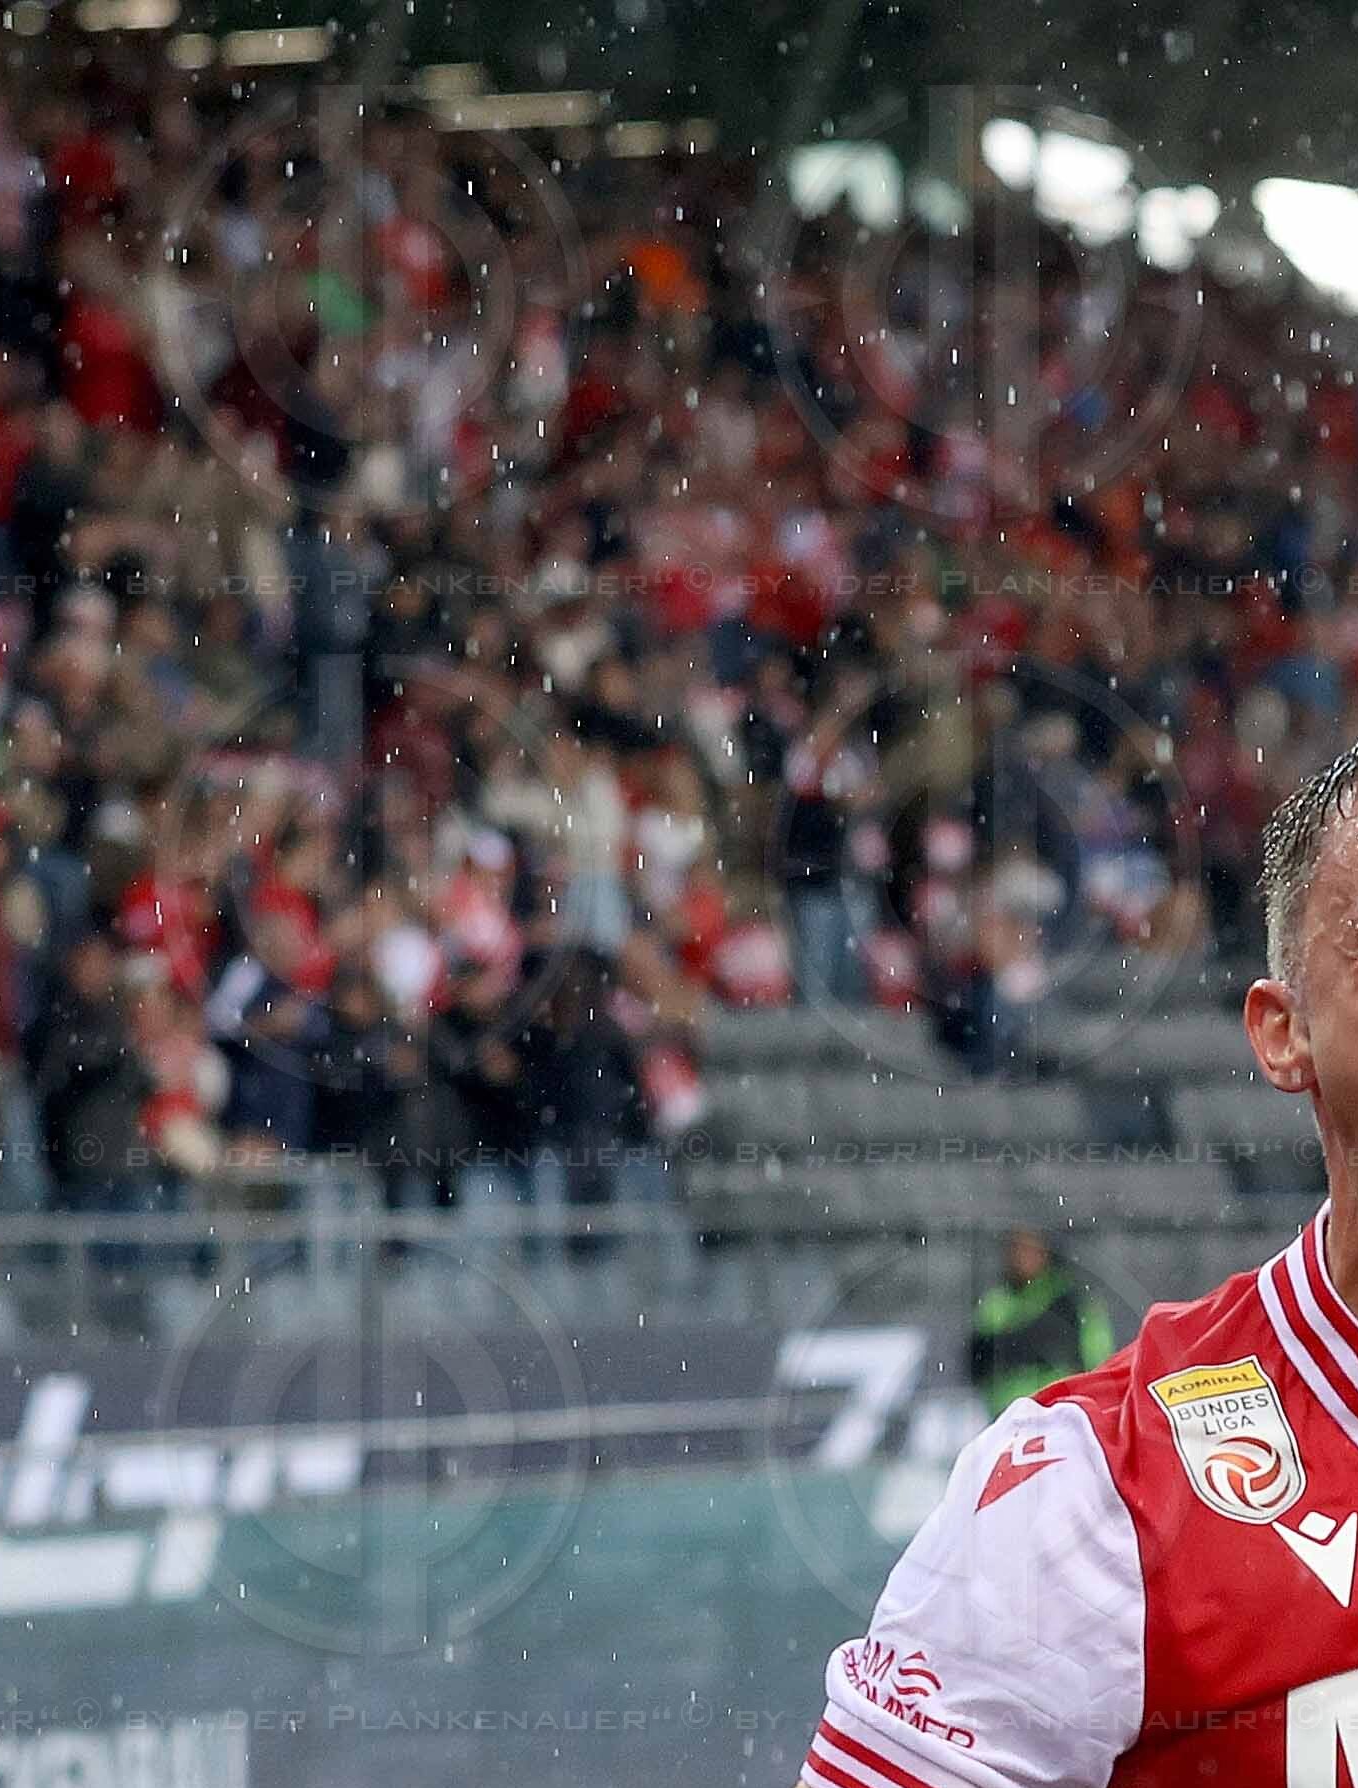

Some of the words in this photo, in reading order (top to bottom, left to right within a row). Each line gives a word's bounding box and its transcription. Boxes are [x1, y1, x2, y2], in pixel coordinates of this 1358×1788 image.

[1167, 1372, 1257, 1399] ADMIRAL
[1176, 1392, 1270, 1421] BUNDES
[1203, 1414, 1256, 1436] LIGA
